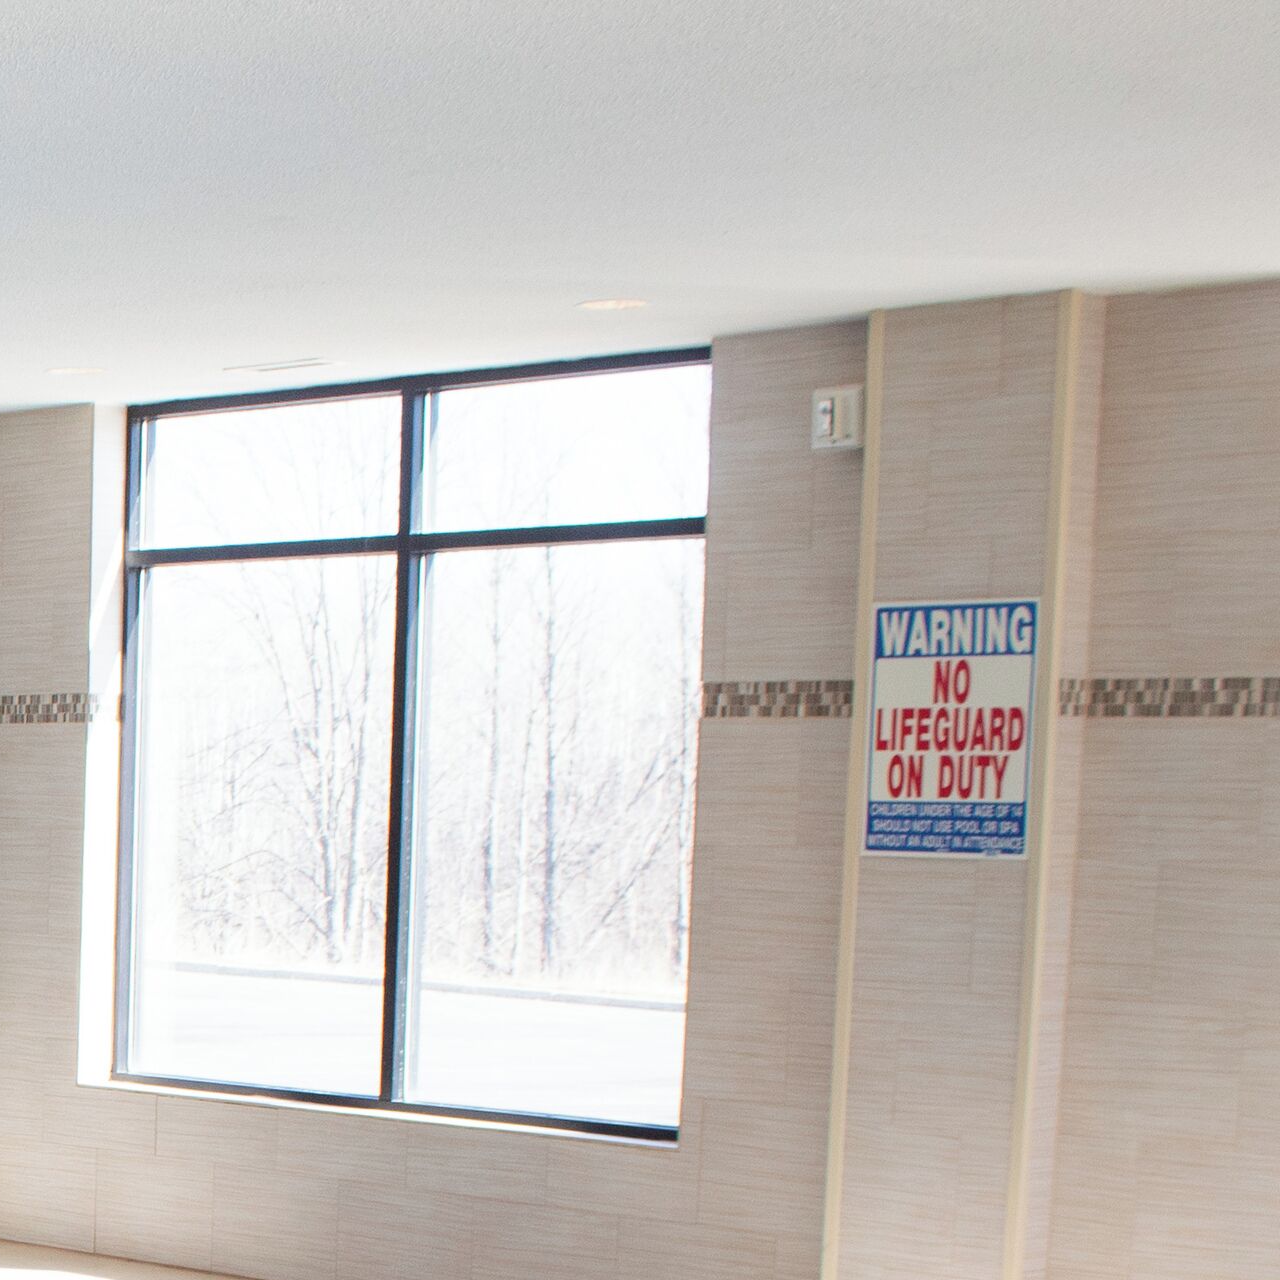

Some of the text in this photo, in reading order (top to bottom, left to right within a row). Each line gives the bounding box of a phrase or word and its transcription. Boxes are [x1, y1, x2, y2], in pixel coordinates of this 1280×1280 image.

[879, 604, 1033, 657] WARNING
[934, 659, 971, 704] NO
[875, 707, 1025, 752] LIFEGUARD
[886, 754, 1011, 799] ON DUTY
